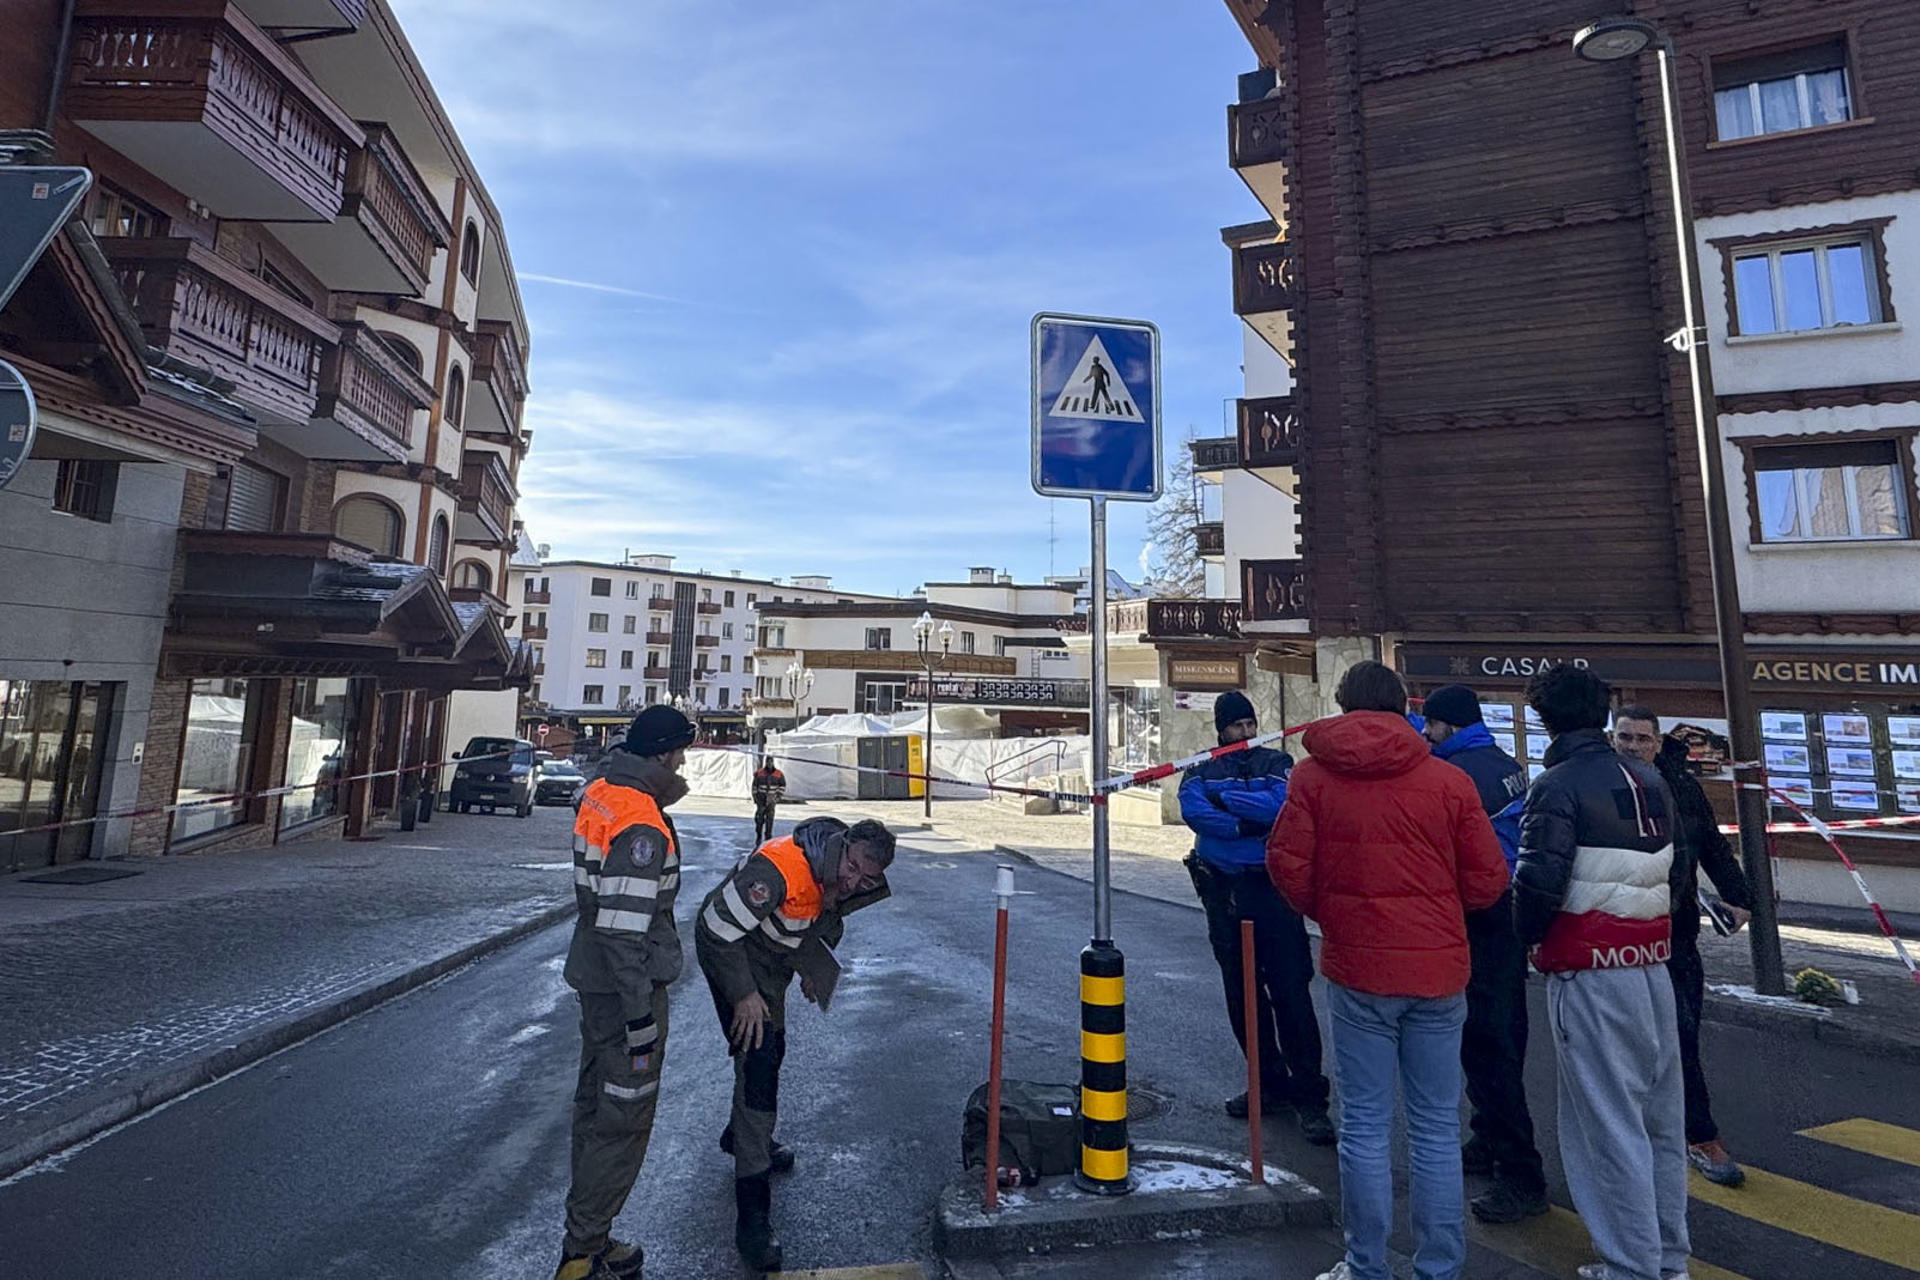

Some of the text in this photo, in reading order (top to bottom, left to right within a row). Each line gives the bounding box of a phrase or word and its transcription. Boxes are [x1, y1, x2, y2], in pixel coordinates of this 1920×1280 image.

[1481, 656, 1589, 676] CASAP
[1752, 661, 1920, 684] AGENCE IM
[1591, 937, 1671, 969] MONCL
